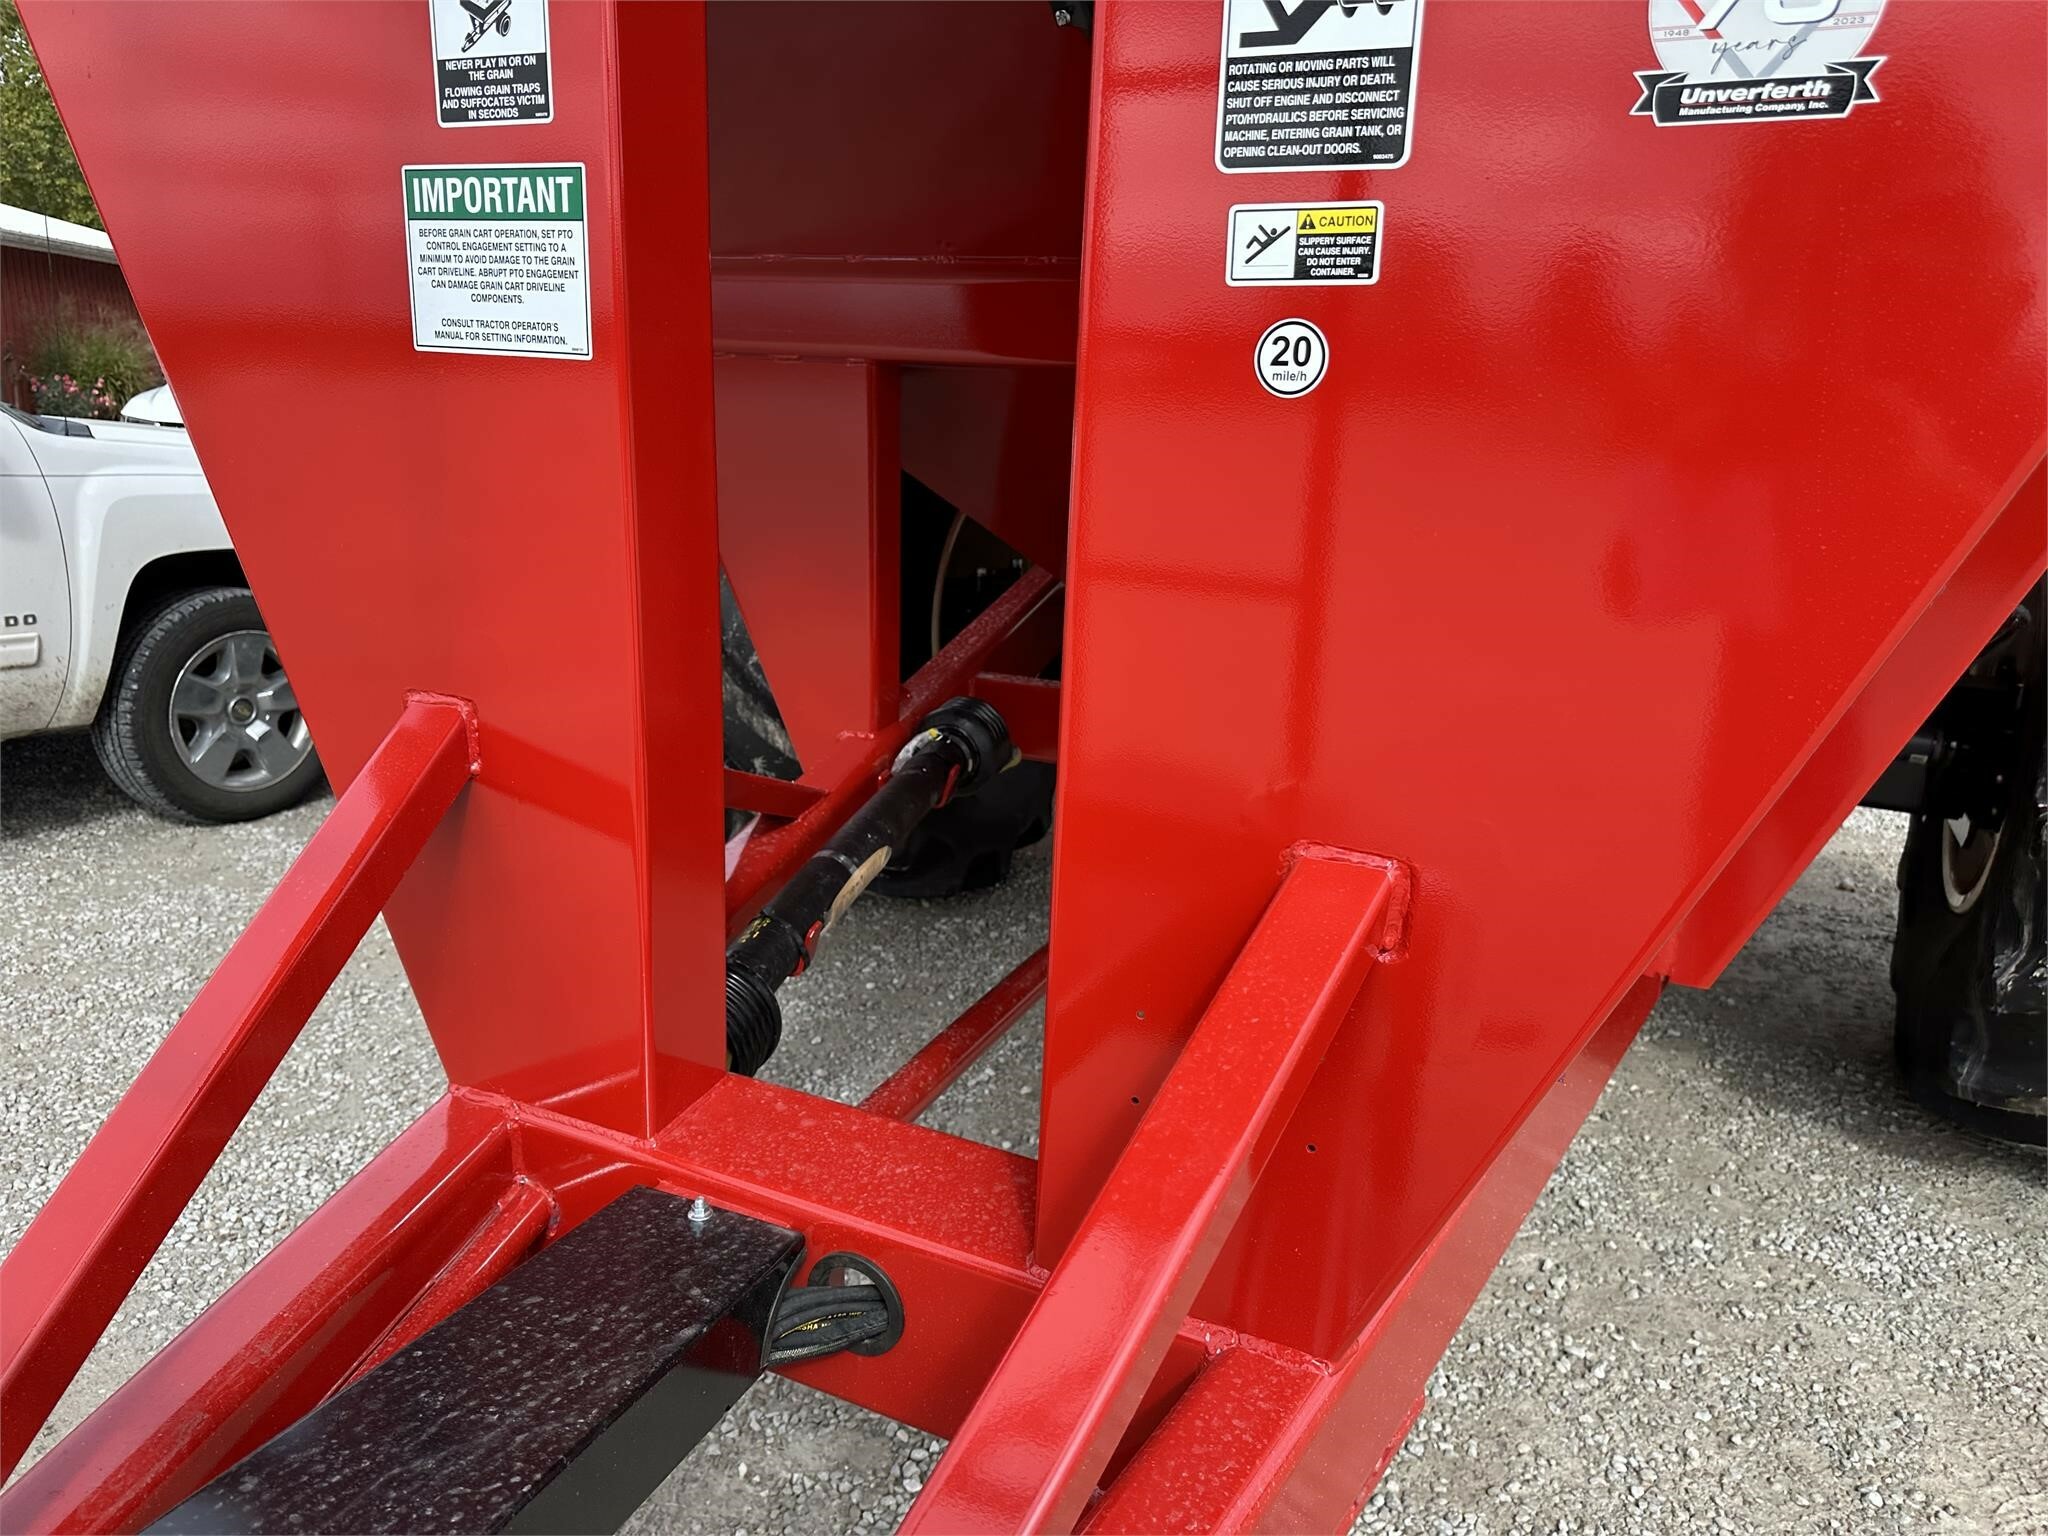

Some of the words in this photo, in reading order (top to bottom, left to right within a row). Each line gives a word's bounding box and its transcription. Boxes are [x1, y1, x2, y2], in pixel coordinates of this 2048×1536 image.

[1833, 17, 1865, 25] 2023
[1664, 29, 1689, 37] 1948
[1711, 35, 1807, 75] years
[446, 60, 473, 70] NEVER
[475, 59, 496, 69] PLAY
[499, 58, 507, 67] IN
[509, 56, 522, 66] OR
[524, 56, 536, 65] ON
[1229, 62, 1277, 75] ROTATING
[1278, 61, 1293, 73] OR
[1295, 59, 1334, 72] MOVING
[1335, 57, 1369, 69] PARTS
[1371, 56, 1395, 67] WILL
[469, 71, 485, 81] THE
[487, 69, 513, 79] GRAIN
[1228, 80, 1260, 92] CAUSE
[1262, 77, 1304, 90] SERIOUS
[1306, 75, 1340, 88] INJURY
[1343, 74, 1357, 85] OR
[1360, 73, 1396, 84] DEATH.
[445, 86, 484, 97] FLOWING
[484, 85, 510, 95] GRAIN
[512, 83, 540, 93] TRAPS
[1680, 80, 1831, 103] Unverferth
[442, 99, 459, 109] AND
[461, 97, 515, 108] SUFFOCATES
[518, 95, 545, 105] VICTIM
[1227, 96, 1251, 108] SHUT
[1254, 95, 1272, 107] OFF
[1275, 93, 1310, 106] ENGINE
[1312, 93, 1332, 104] AND
[1335, 90, 1400, 104] DISCONNECT
[468, 110, 476, 119] IN
[479, 108, 518, 118] SECONDS
[1679, 102, 1753, 116] Manufacturing
[1755, 102, 1805, 113] Company,
[1808, 100, 1828, 109] Inc.
[1226, 111, 1307, 125] PTO/HYDRAULICS
[1309, 109, 1349, 122] BEFORE
[1351, 107, 1404, 120] SERVICING
[1225, 129, 1269, 142] MACHINE,
[1271, 127, 1319, 140] ENTERING
[1322, 126, 1352, 138] GRAIN
[1355, 125, 1385, 137] TANK,
[1387, 125, 1402, 135] OR
[1224, 146, 1265, 158] OPENING
[1267, 144, 1323, 156] CLEAN-OUT
[1325, 143, 1361, 154] DOORS.
[413, 176, 573, 213] IMPORTANT
[1319, 216, 1373, 227] CAUTION
[419, 229, 446, 238] BEFORE
[449, 229, 471, 238] GRAIN
[473, 230, 492, 238] CART
[495, 230, 539, 240] OPERATION,
[541, 230, 556, 239] SET
[558, 230, 573, 239] PTO
[1299, 237, 1335, 245] SLIPPERY
[1336, 236, 1372, 244] SURFACE
[427, 242, 460, 251] CONTROL
[463, 242, 512, 251] ENGAGEMENT
[514, 243, 546, 251] SETTING
[548, 243, 559, 251] TO
[561, 243, 566, 251] A
[1298, 247, 1313, 255] CAN
[1315, 247, 1340, 255] CAUSE
[420, 255, 451, 263] MINIMUM
[453, 255, 463, 263] TO
[465, 255, 487, 264] AVOID
[489, 256, 520, 265] DAMAGE
[522, 256, 532, 265] TO
[534, 256, 549, 265] THE
[551, 256, 575, 266] GRAIN
[1337, 257, 1361, 265] ENTER
[418, 267, 436, 276] CART
[438, 268, 477, 277] DRIVELINE.
[479, 269, 507, 278] ABRUPT
[509, 269, 524, 278] PTO
[526, 270, 579, 279] ENGAGEMENT
[1310, 268, 1355, 276] CONTAINER.
[431, 280, 446, 289] CAN
[448, 281, 478, 290] DAMAGE
[480, 281, 503, 290] GRAIN
[505, 282, 524, 291] CART
[526, 282, 565, 292] DRIVELINE
[471, 294, 524, 304] COMPONENTS.
[442, 318, 474, 328] CONSULT
[476, 320, 509, 329] TRACTOR
[512, 321, 558, 332] OPERATOR'S
[435, 332, 464, 340] MANUAL
[465, 333, 480, 341] FOR
[482, 333, 512, 343] SETTING
[514, 335, 568, 345] INFORMATION.
[1271, 336, 1311, 367] 20
[1272, 371, 1306, 381] mile/h
